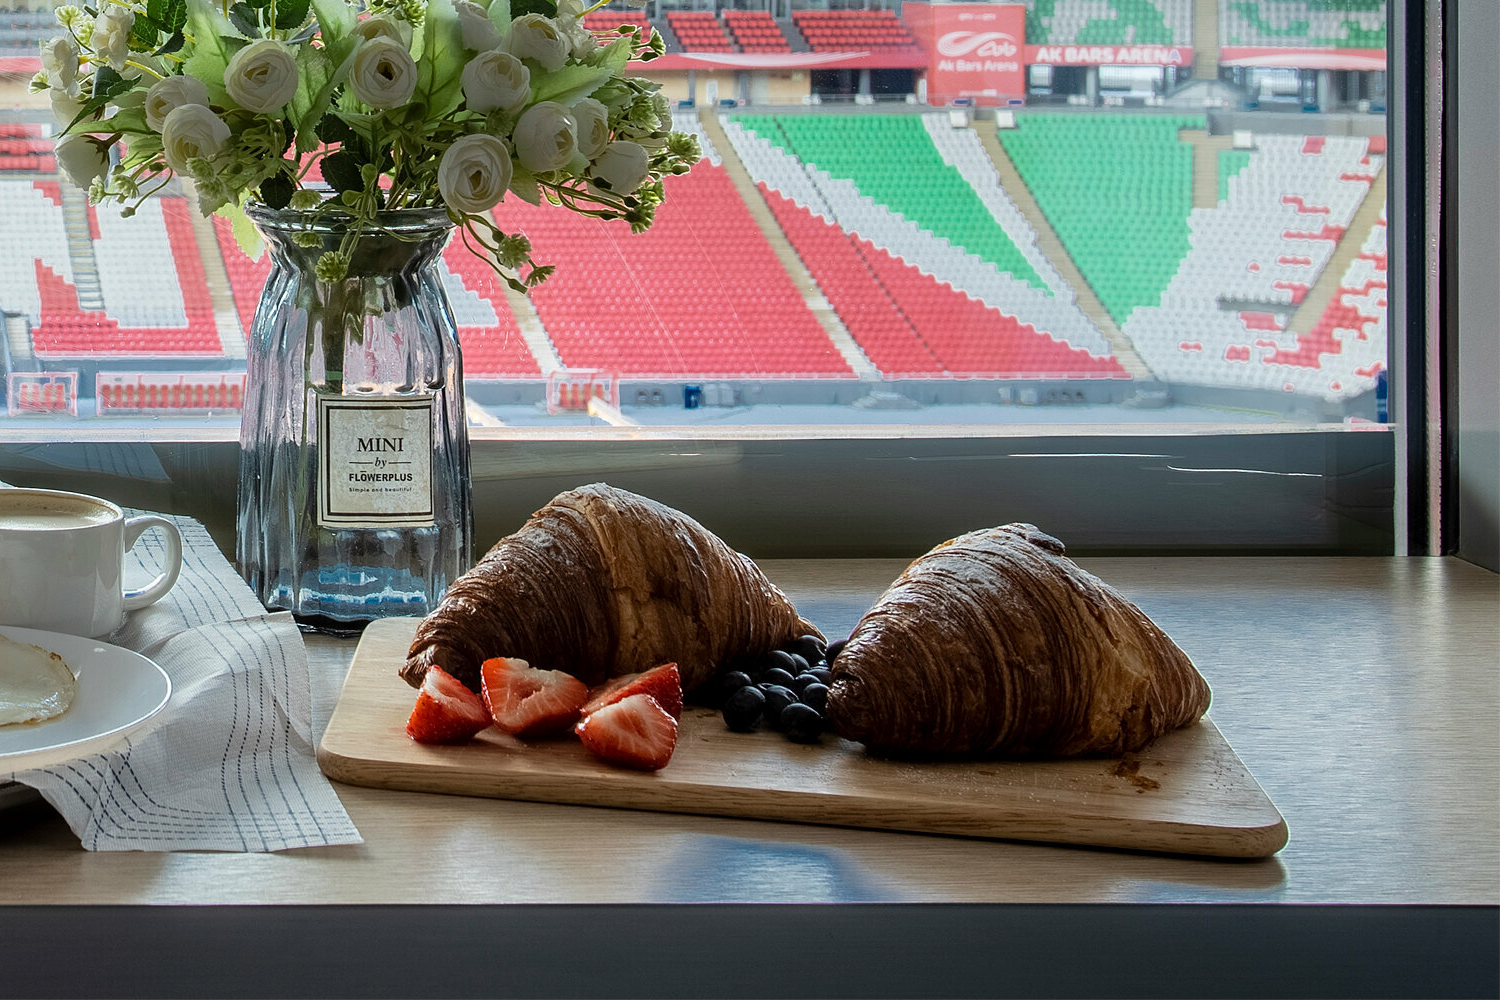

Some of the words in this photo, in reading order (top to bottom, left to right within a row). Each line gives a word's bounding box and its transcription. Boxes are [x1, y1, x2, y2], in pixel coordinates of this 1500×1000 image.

[1036, 47, 1062, 63] AK
[1064, 47, 1115, 64] BARS
[1116, 47, 1183, 64] ARENA
[357, 437, 404, 452] MINI
[374, 457, 387, 469] by
